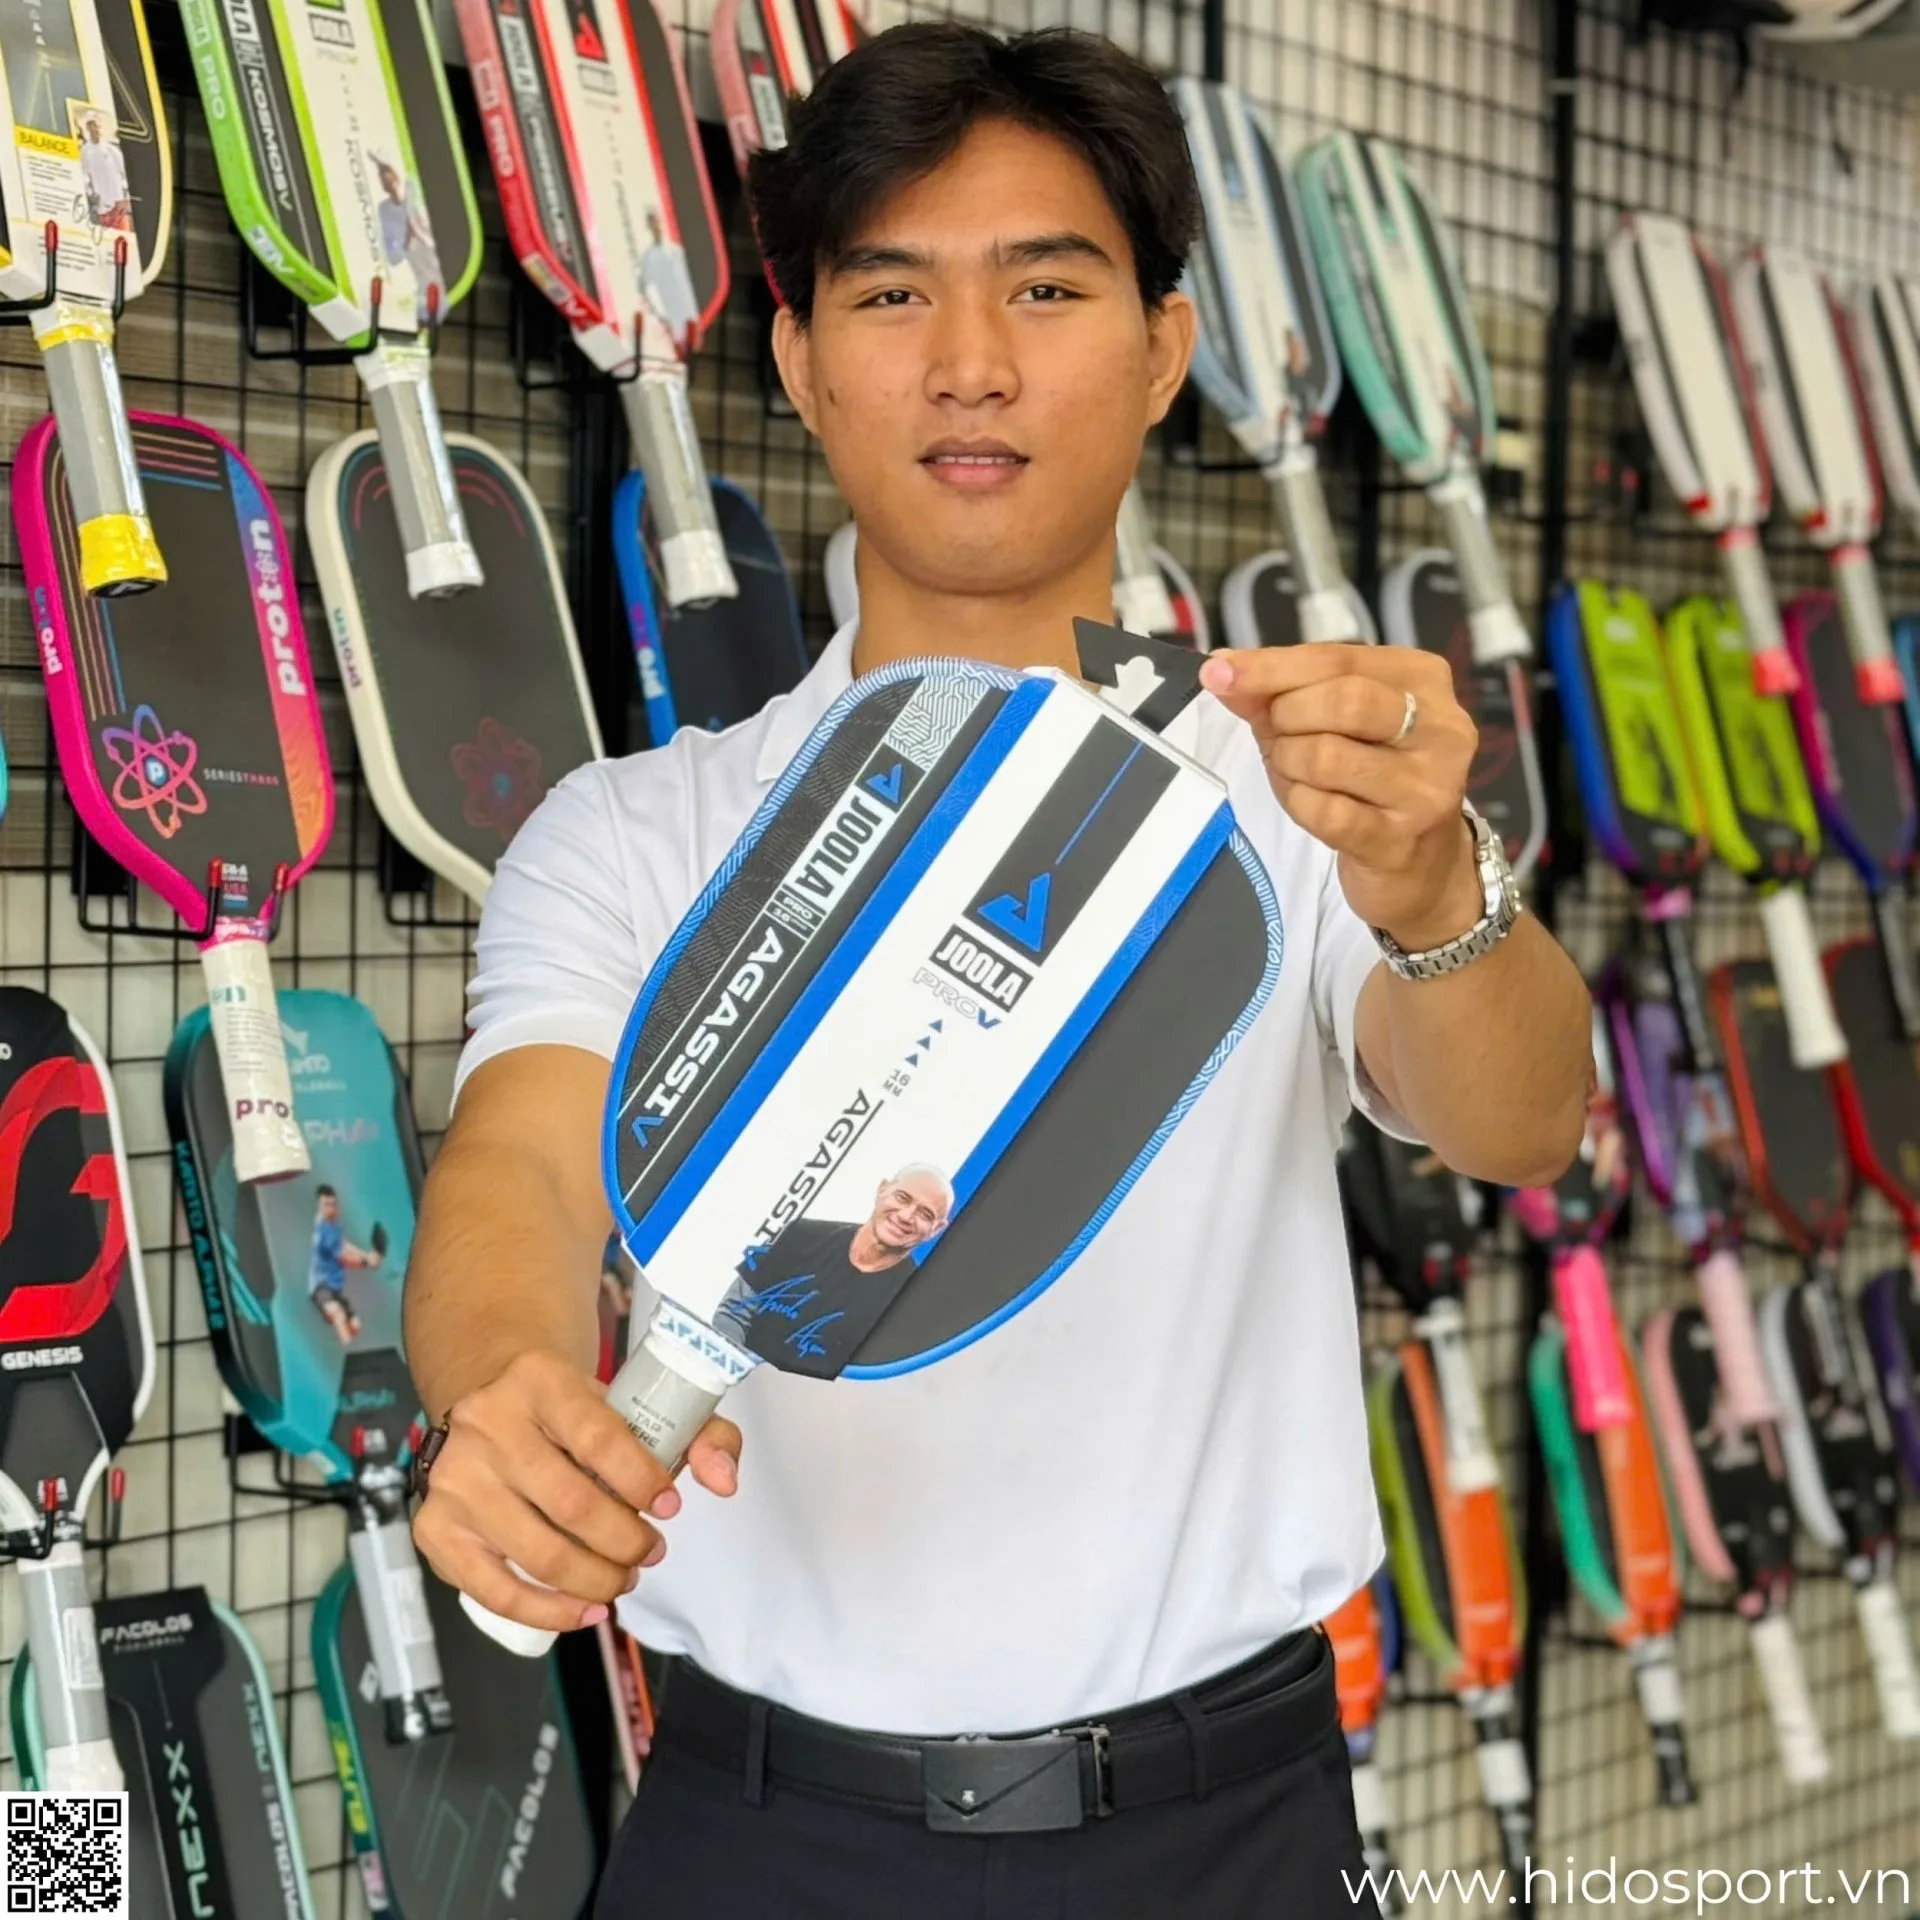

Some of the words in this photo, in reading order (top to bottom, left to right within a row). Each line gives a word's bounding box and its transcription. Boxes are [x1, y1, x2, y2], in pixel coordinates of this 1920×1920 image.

[796, 794, 883, 900] JOOLA
[783, 896, 813, 920] PRO
[935, 934, 1024, 1007] JOOLA
[889, 1068, 912, 1087] 16
[1, 1346, 84, 1370] GENESIS
[100, 1613, 194, 1645] FACOLOS
[501, 1722, 560, 1899] FACOLOS
